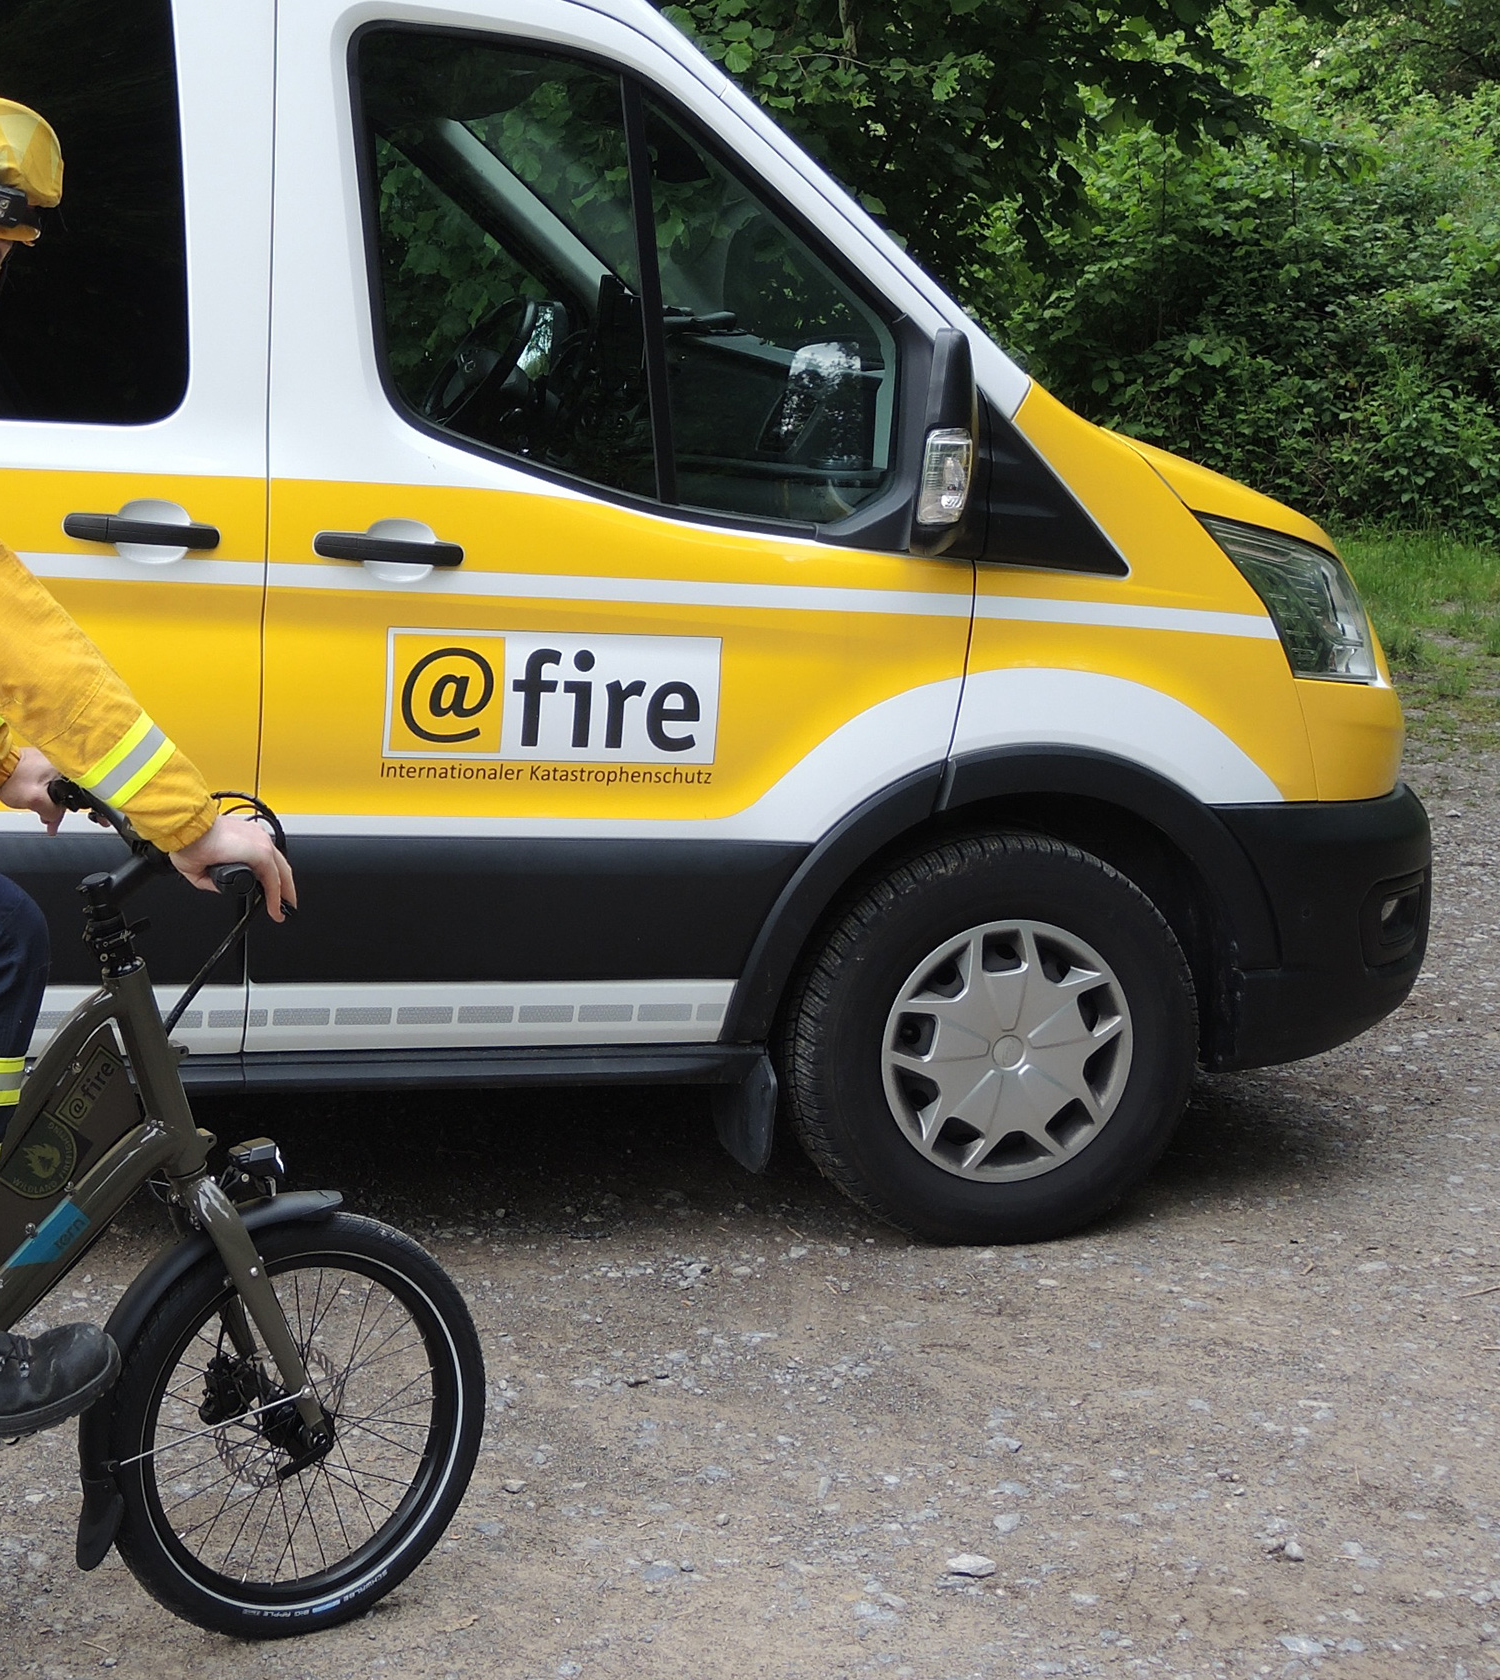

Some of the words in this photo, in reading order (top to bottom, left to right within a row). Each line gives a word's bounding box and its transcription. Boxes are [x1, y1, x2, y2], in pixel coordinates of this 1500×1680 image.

[401, 647, 701, 753] @fire
[379, 762, 524, 782] Internationaler
[529, 764, 713, 787] Katastrophenschutz
[68, 1061, 115, 1120] @fire
[12, 1176, 58, 1195] WILDLAND
[343, 1568, 388, 1602] SCHWALBE
